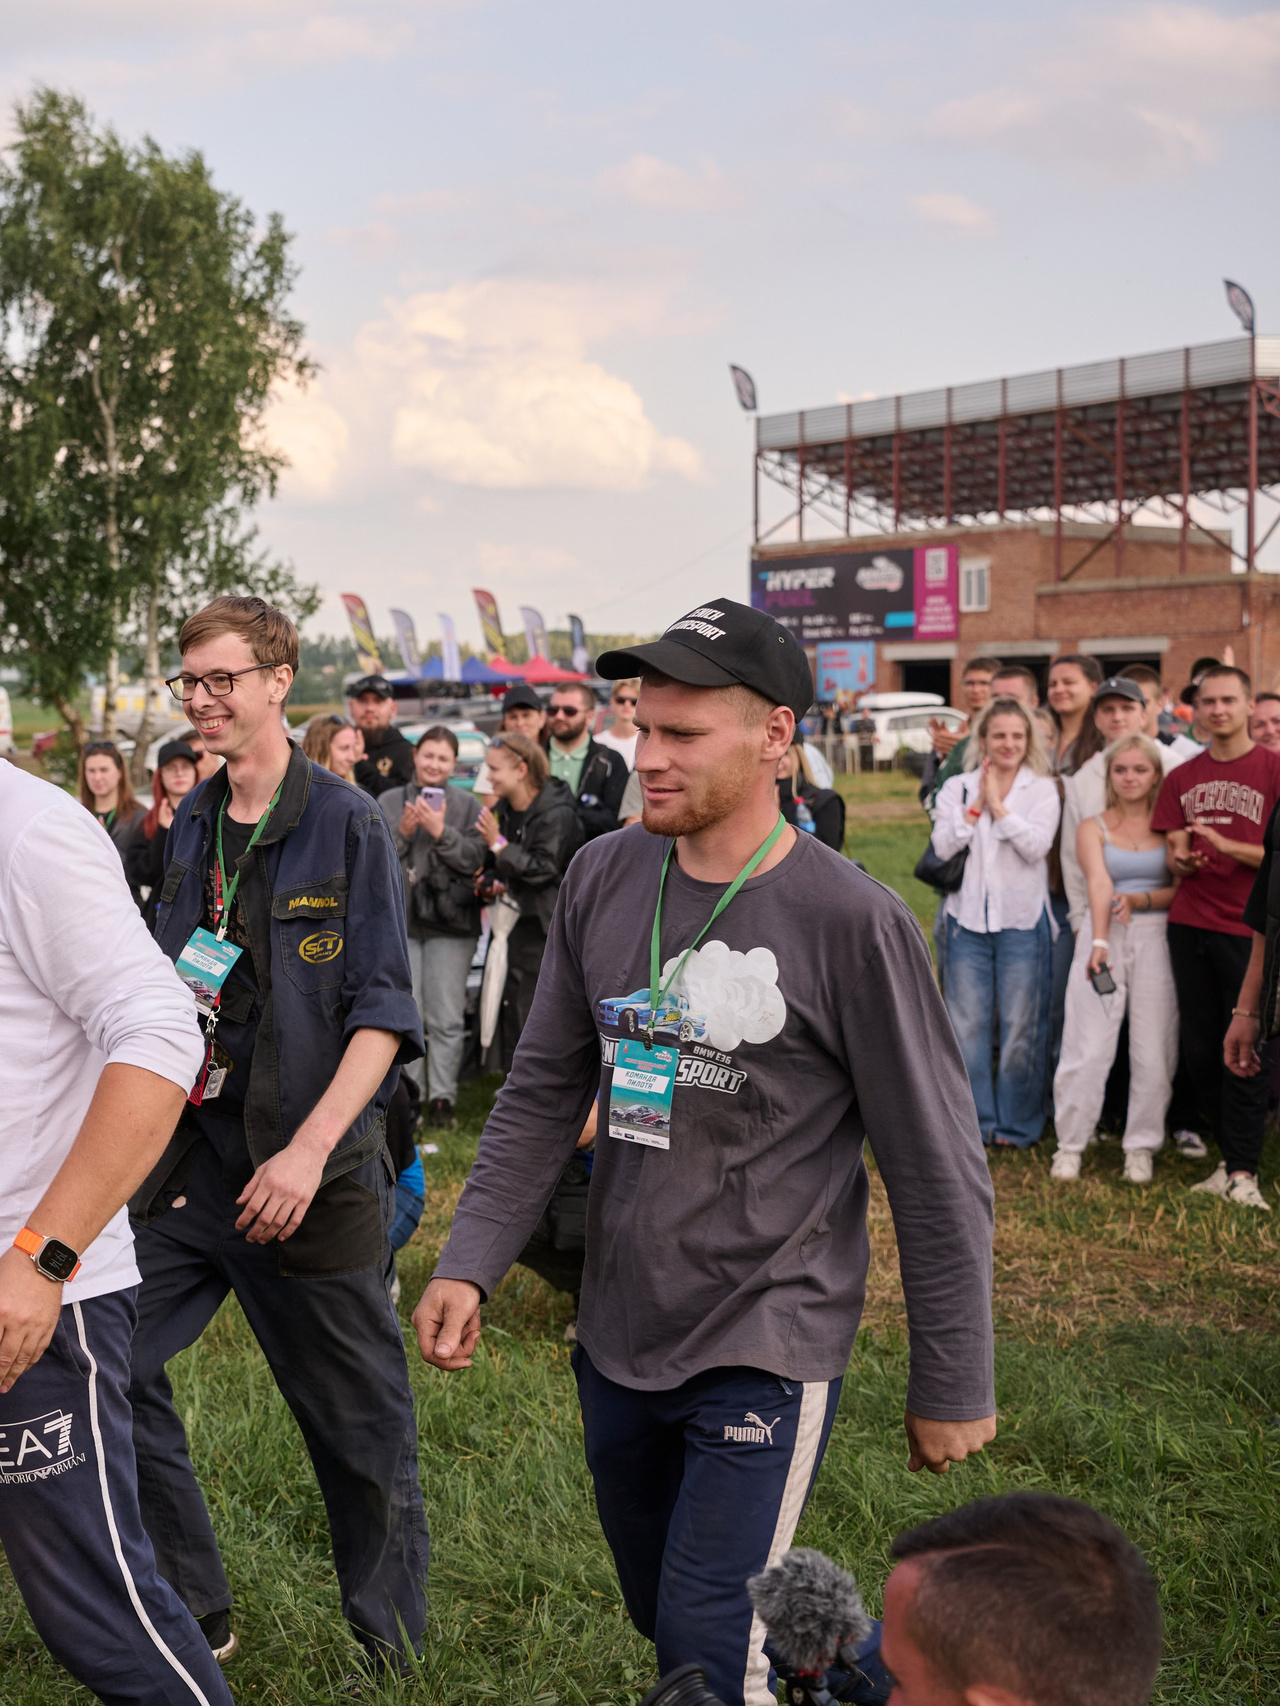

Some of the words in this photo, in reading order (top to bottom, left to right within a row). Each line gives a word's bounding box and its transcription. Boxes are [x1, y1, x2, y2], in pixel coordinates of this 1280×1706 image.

[765, 567, 836, 592] HYPER
[304, 936, 338, 956] SCT
[693, 1046, 715, 1059] BMW
[715, 1053, 733, 1065] E36
[624, 1070, 657, 1083] КОМАНДА
[676, 1058, 744, 1090] SPORT
[626, 1079, 654, 1090] ПИЛОТА
[723, 1425, 766, 1444] PUMA
[51, 1452, 86, 1476] ARMANI
